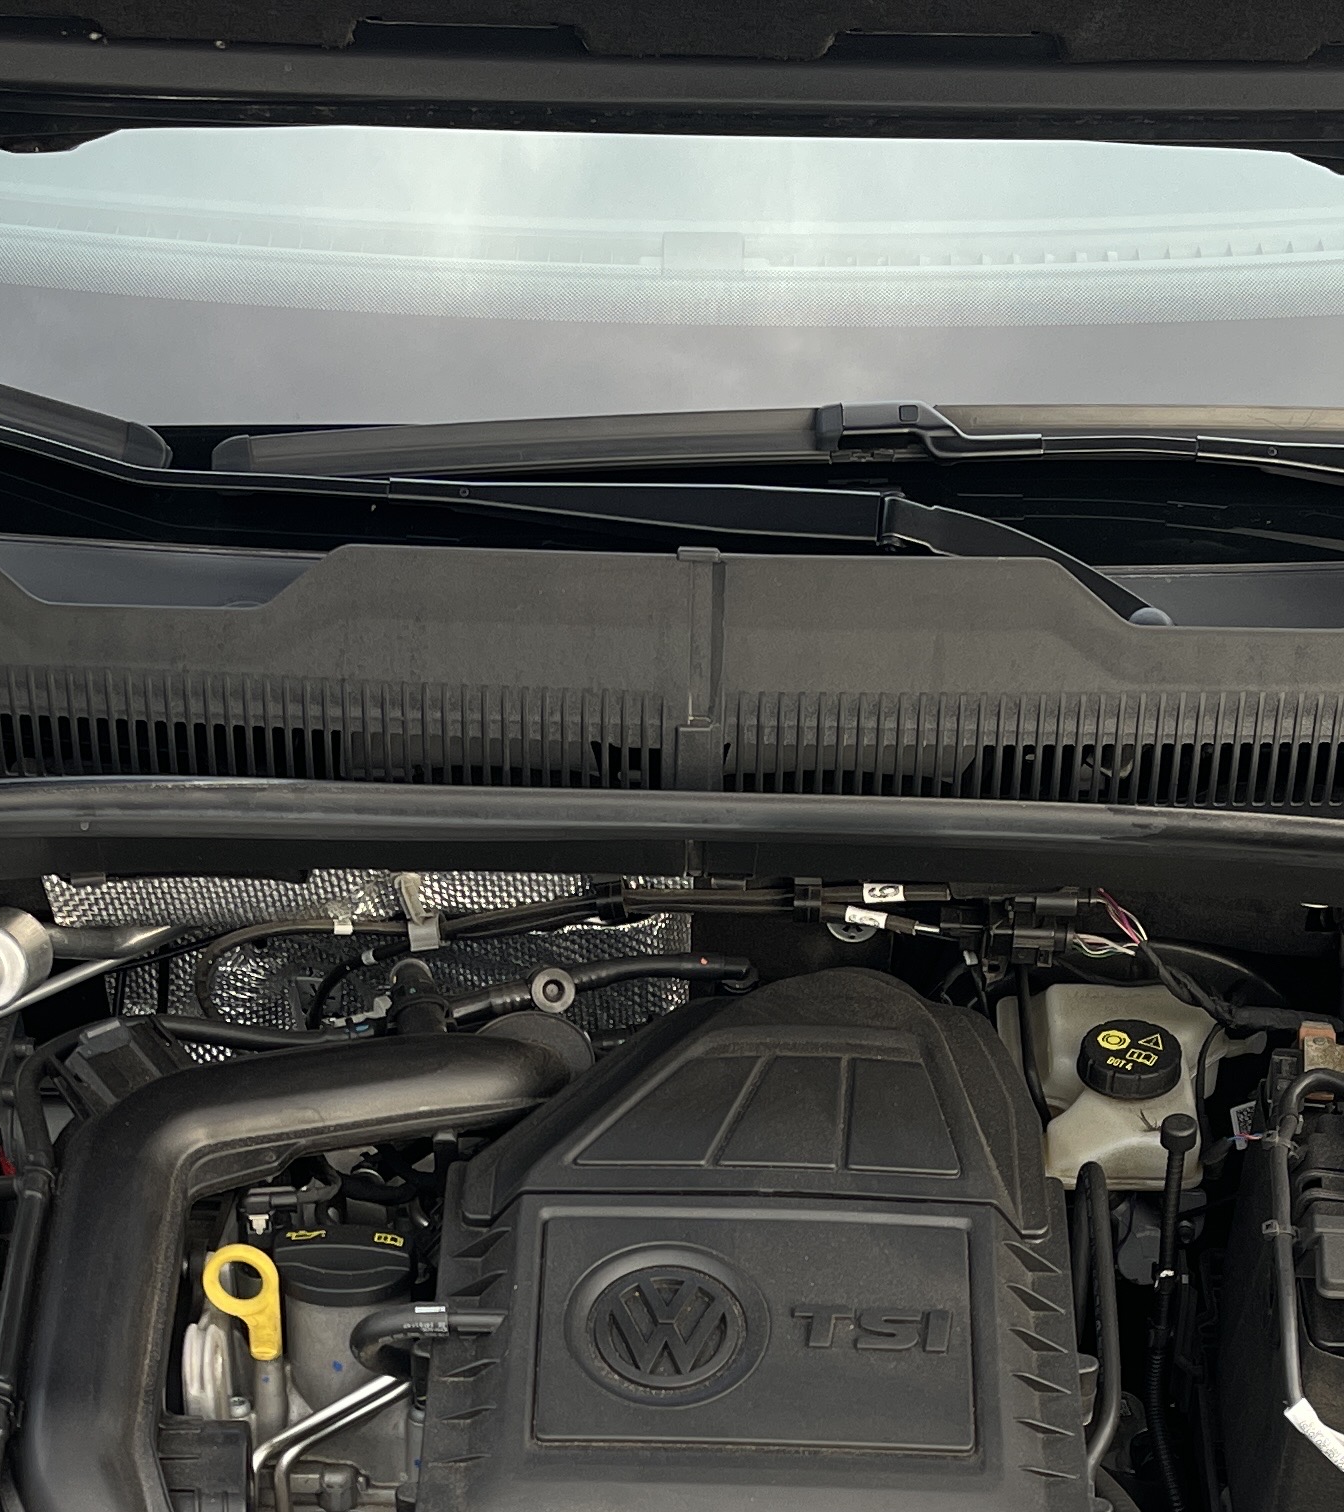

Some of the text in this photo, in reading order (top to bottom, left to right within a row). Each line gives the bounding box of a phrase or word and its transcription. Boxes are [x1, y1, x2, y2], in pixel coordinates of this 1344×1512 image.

[1107, 1056, 1134, 1071] DOT 4
[792, 1303, 954, 1354] TSI
